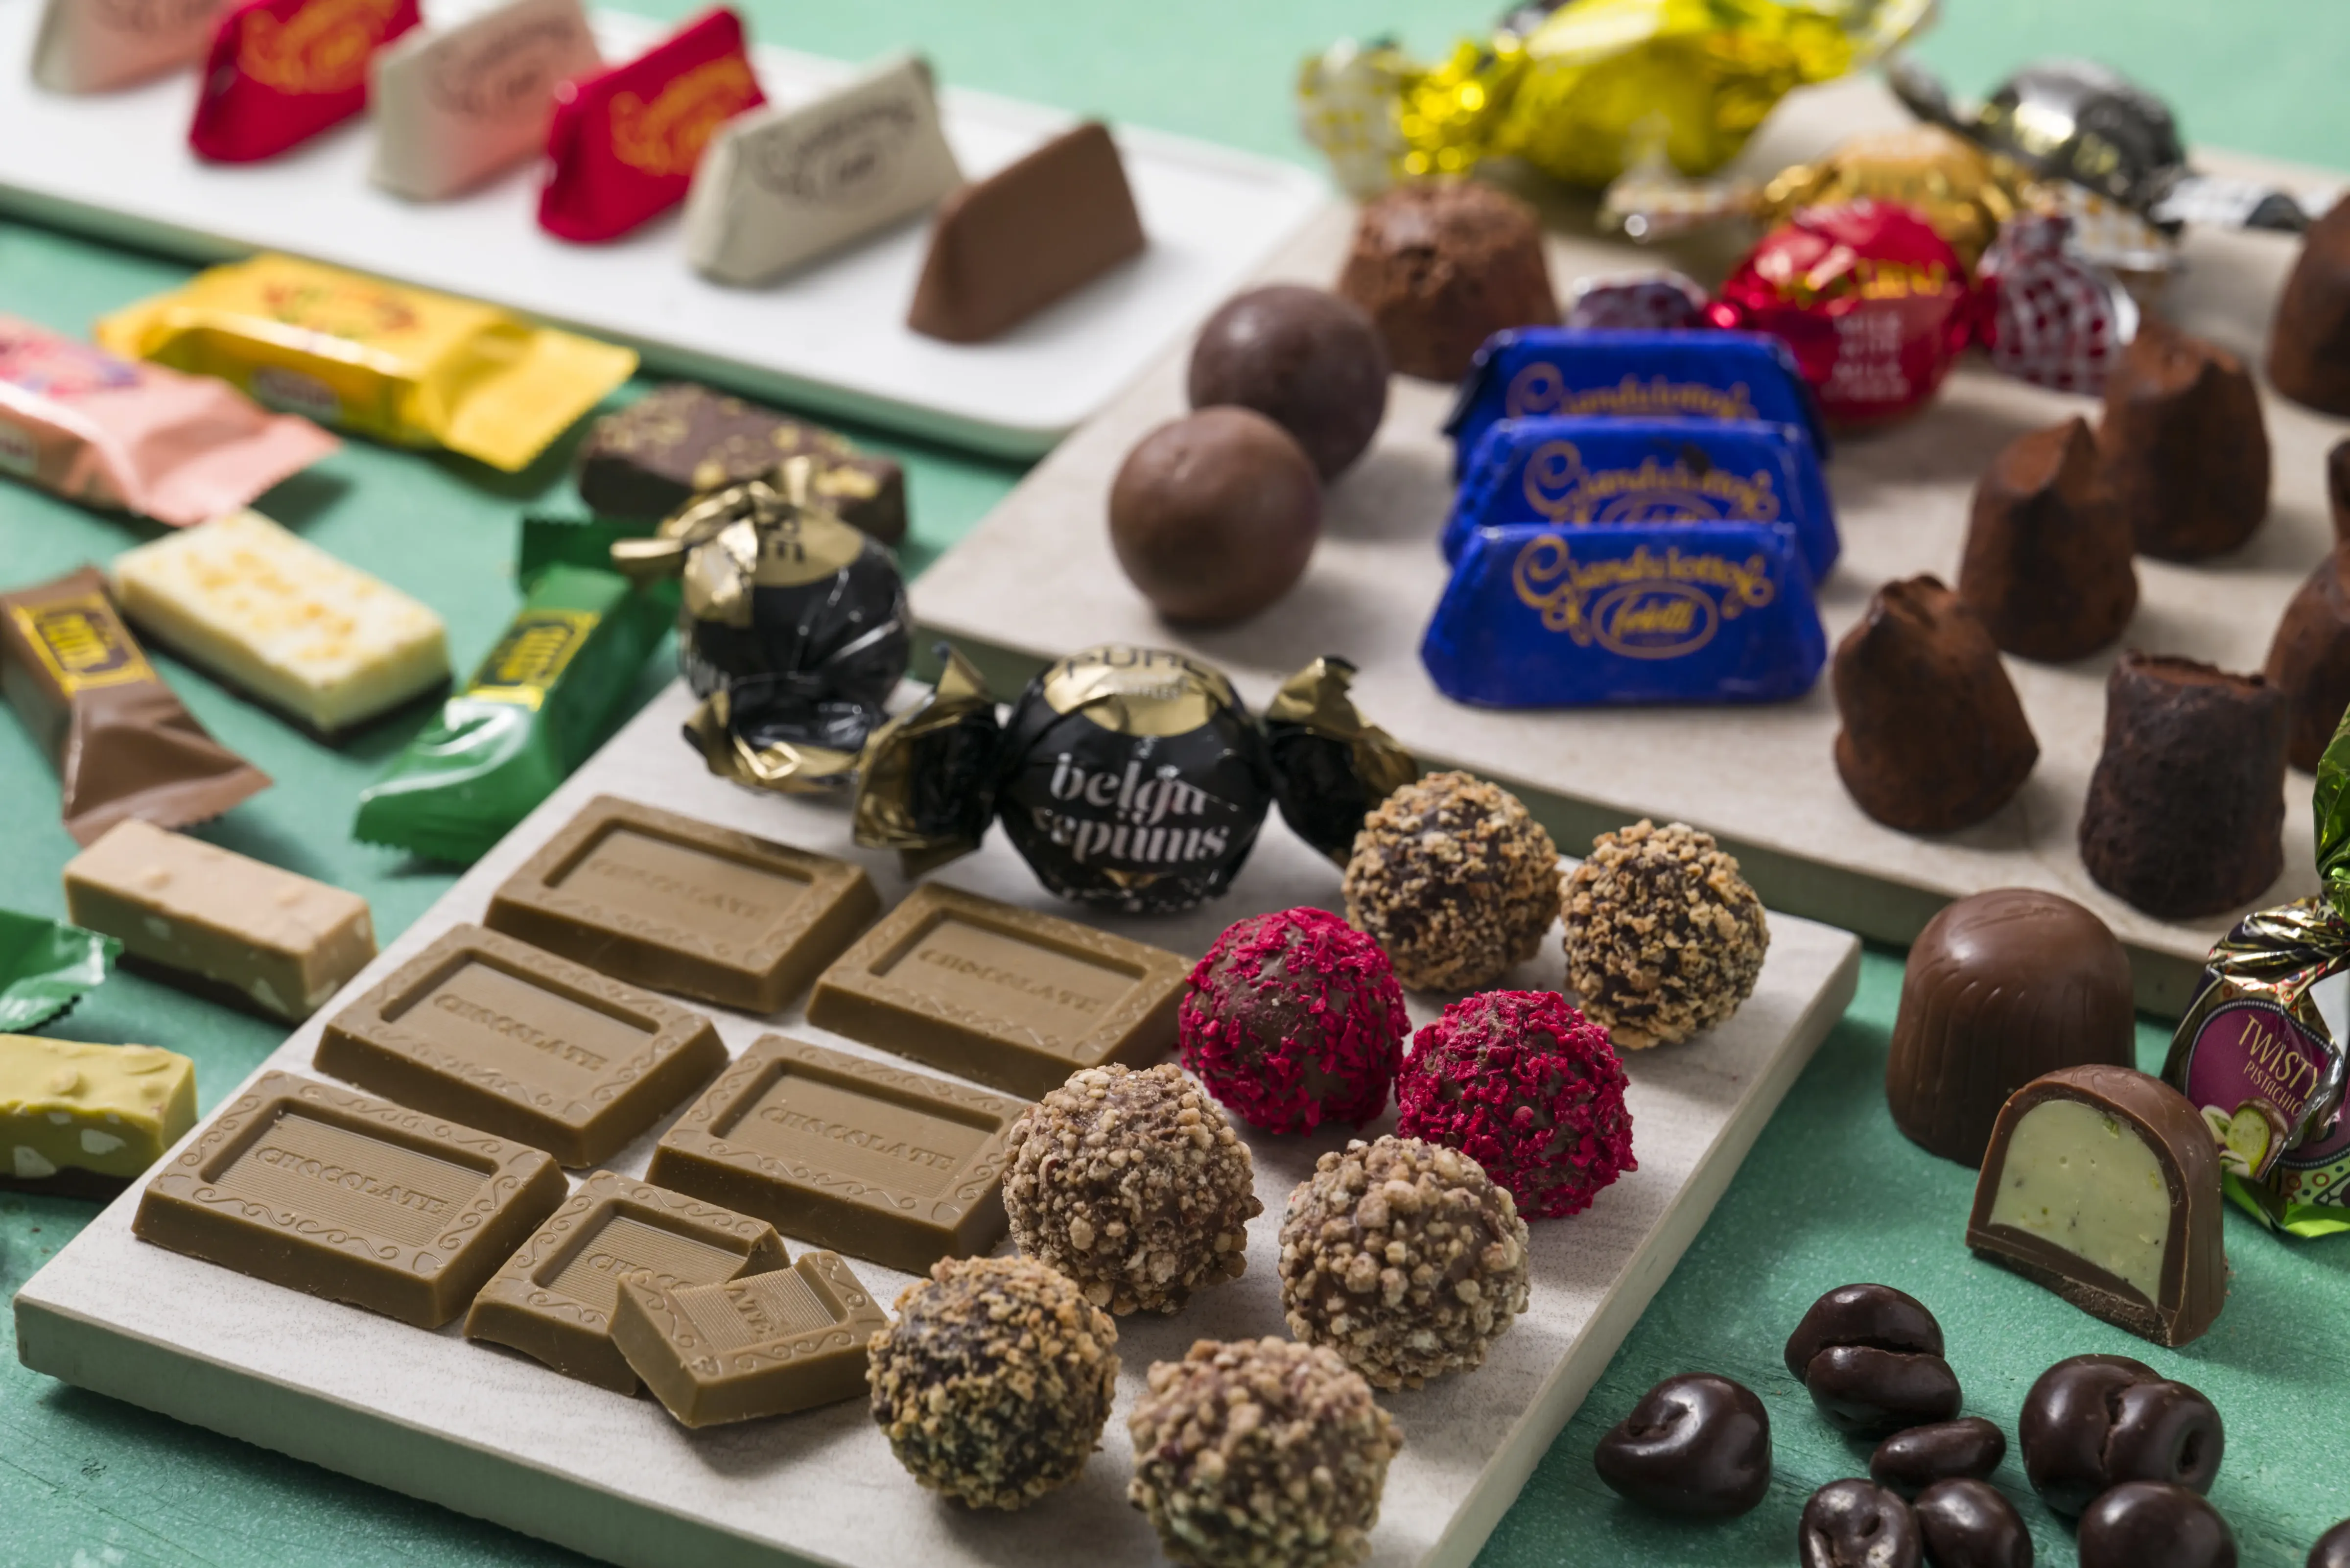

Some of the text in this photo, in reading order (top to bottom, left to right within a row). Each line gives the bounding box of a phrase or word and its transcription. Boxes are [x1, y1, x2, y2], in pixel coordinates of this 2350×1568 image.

[2238, 1014, 2318, 1100] TWISTY
[760, 1106, 956, 1171] CHOCOLATE
[256, 1147, 449, 1214] CHOCOLATE
